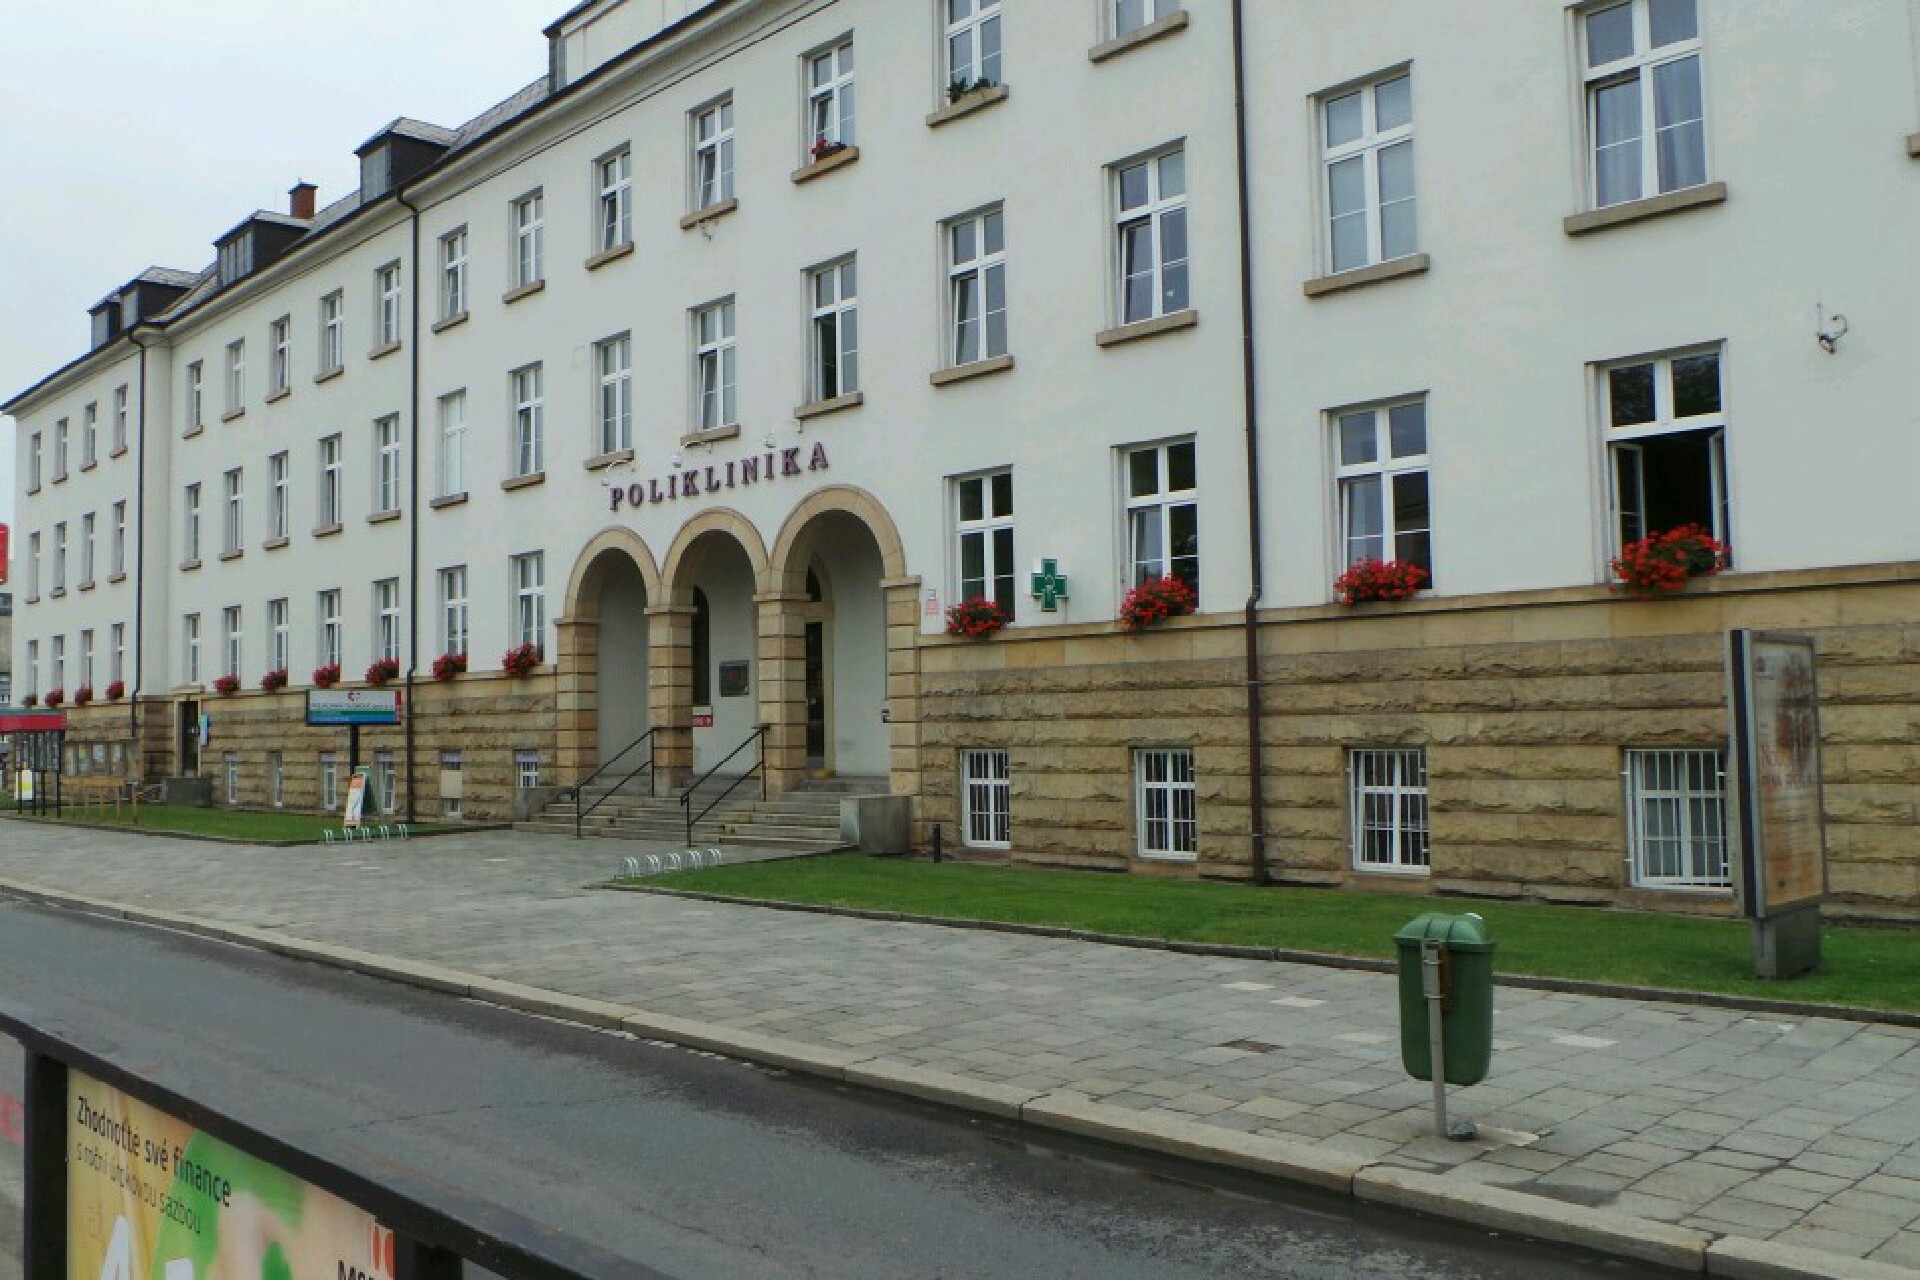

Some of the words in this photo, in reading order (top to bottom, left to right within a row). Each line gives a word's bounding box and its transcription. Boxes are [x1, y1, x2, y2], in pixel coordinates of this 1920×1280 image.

[609, 441, 829, 512] POLIKLINIKA
[77, 1142, 82, 1160] s
[145, 1138, 169, 1172] své
[173, 1145, 231, 1207] finance
